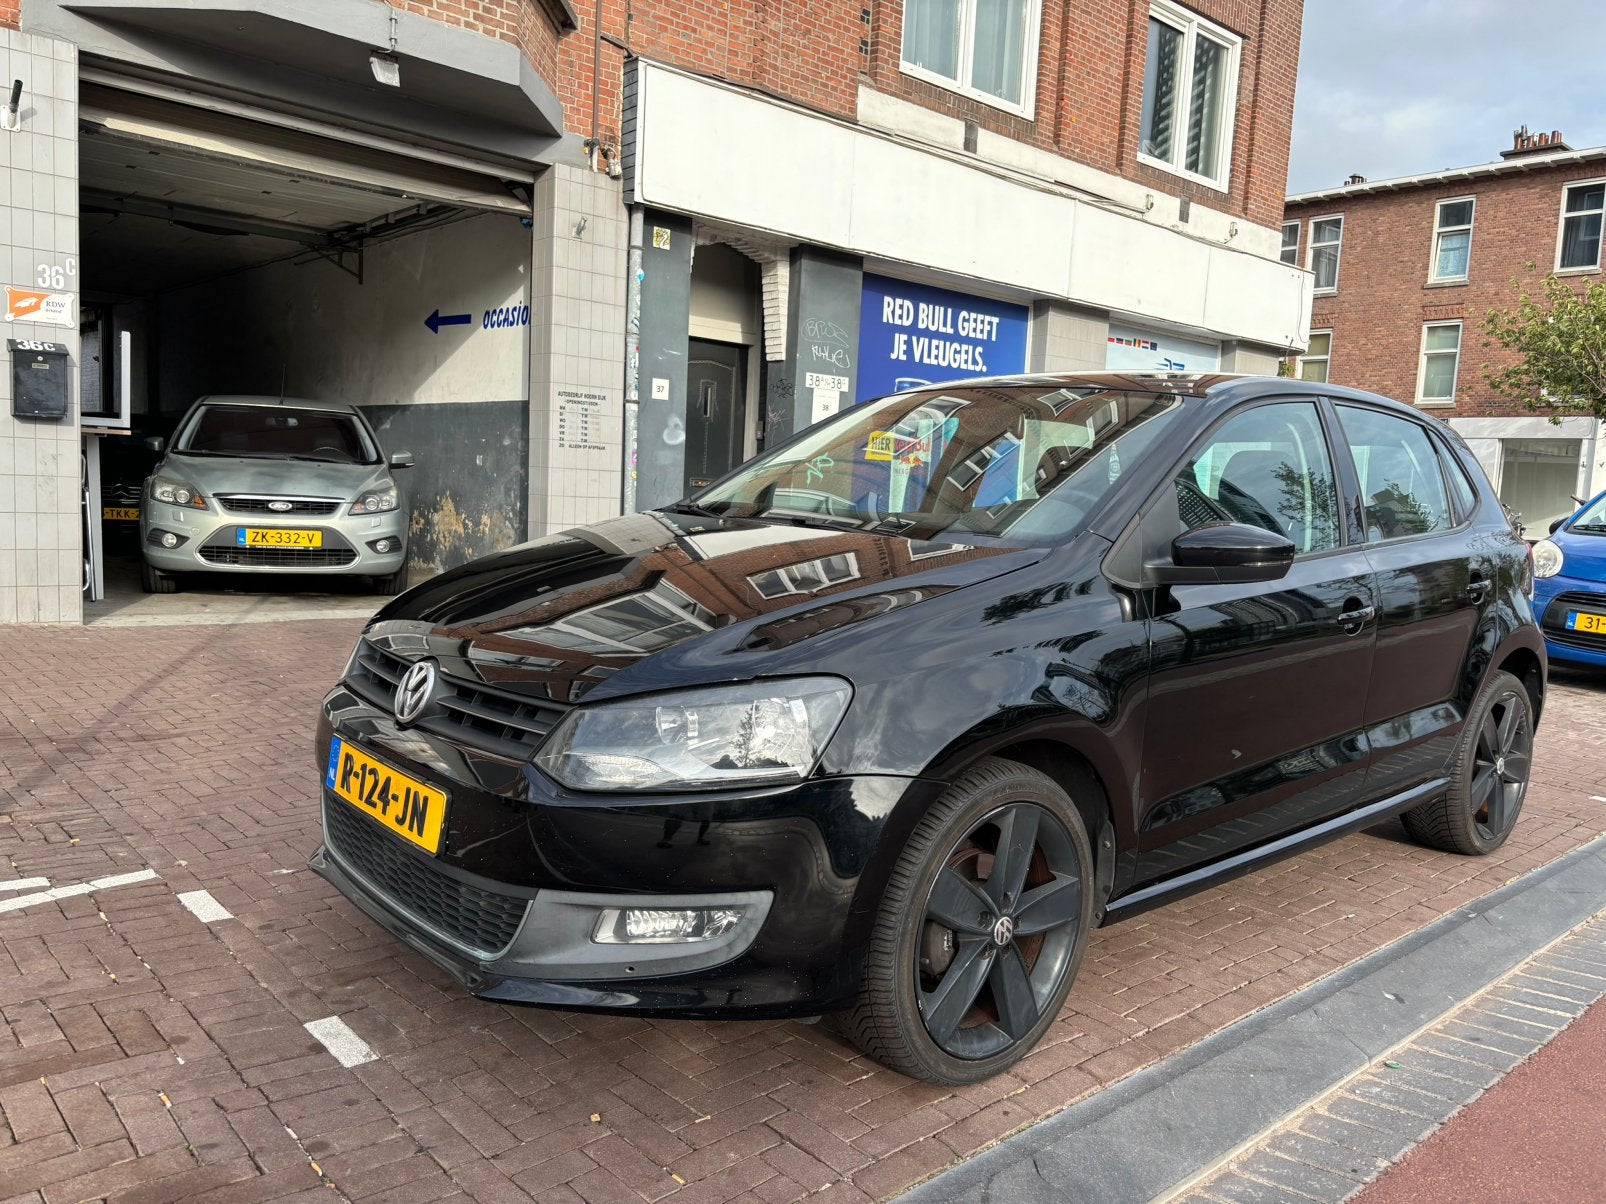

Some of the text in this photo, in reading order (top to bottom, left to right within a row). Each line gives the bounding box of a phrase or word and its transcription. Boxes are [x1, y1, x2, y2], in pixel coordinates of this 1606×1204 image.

[46, 300, 66, 308] RDW
[882, 295, 999, 341] RED BULL GEEFT
[890, 333, 988, 372] JE VLEUGELS.
[656, 385, 665, 393] 37
[871, 436, 891, 451] HIER
[251, 531, 315, 545] ZK-332-V
[340, 751, 430, 838] R-124-JN
